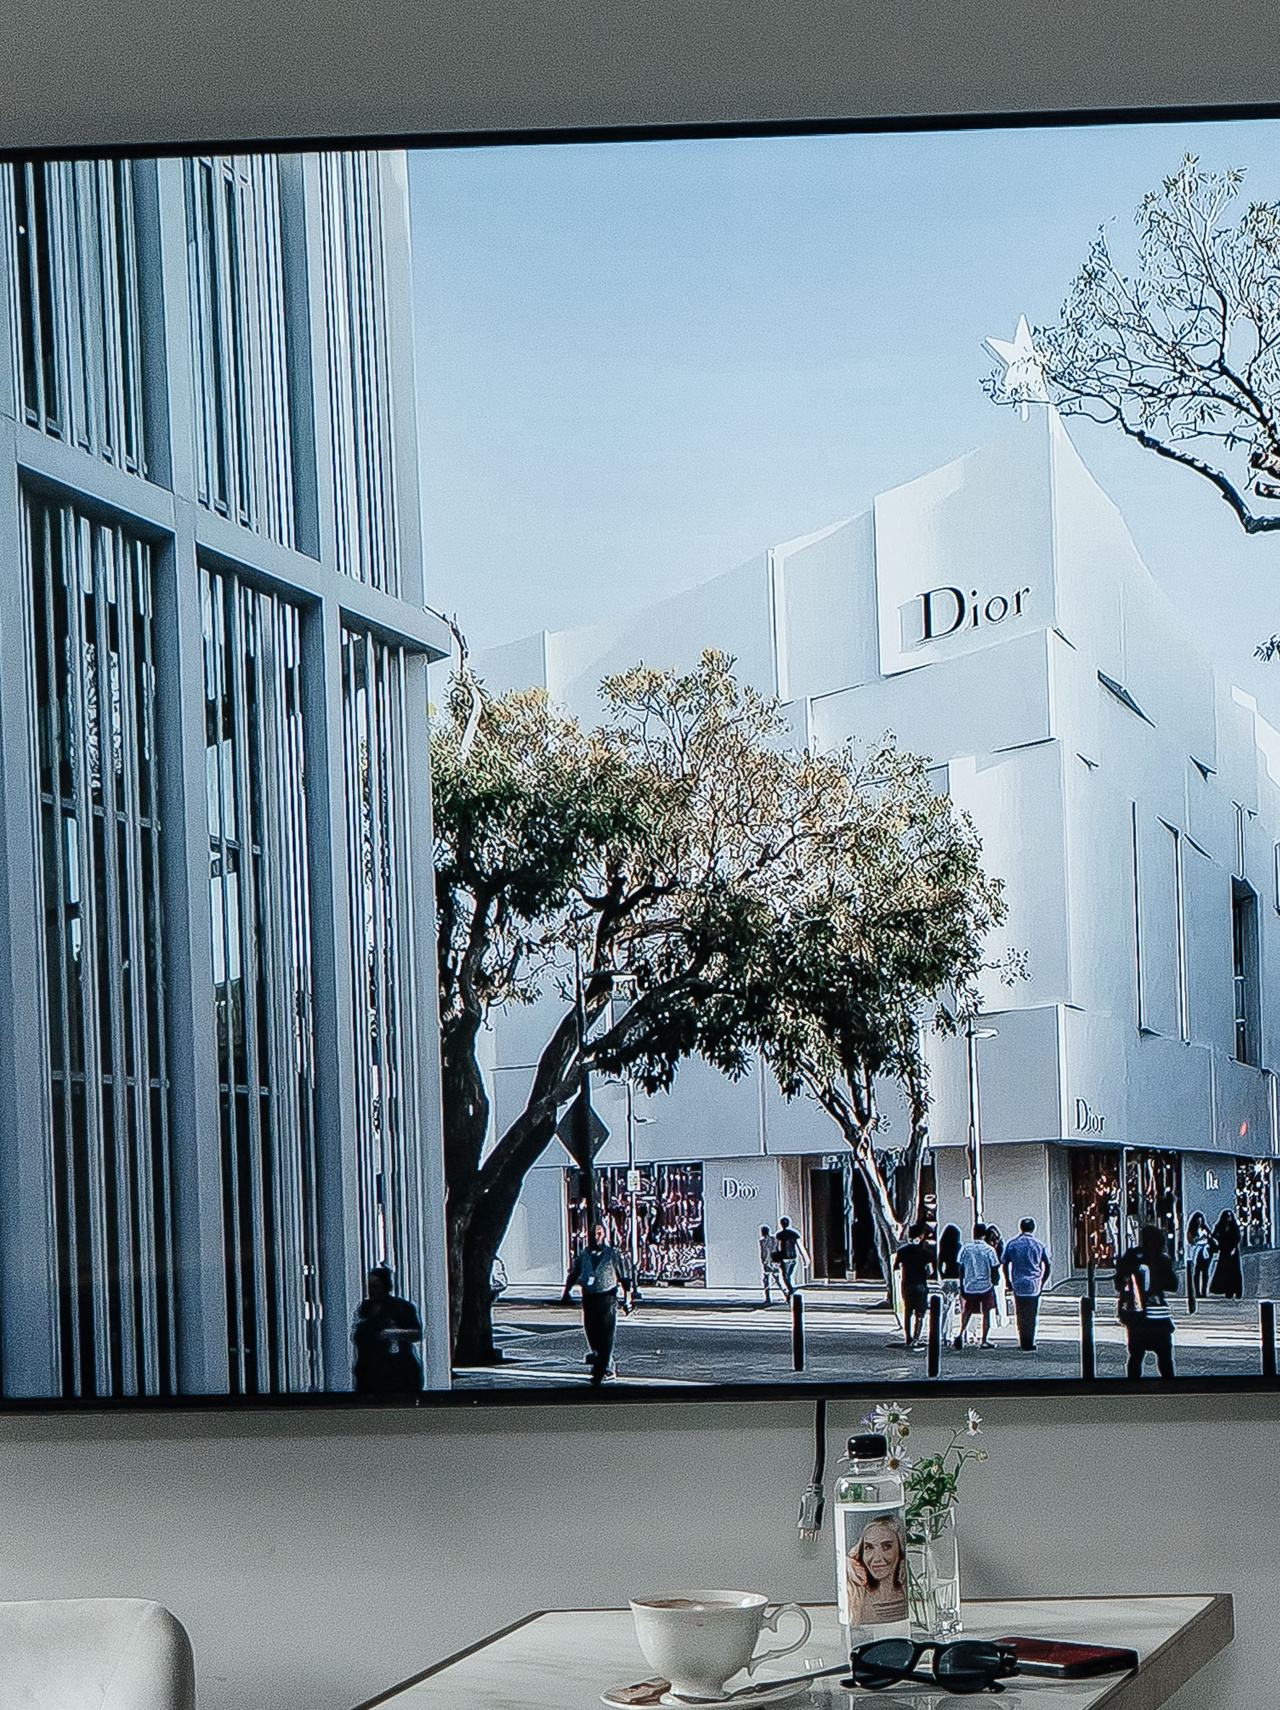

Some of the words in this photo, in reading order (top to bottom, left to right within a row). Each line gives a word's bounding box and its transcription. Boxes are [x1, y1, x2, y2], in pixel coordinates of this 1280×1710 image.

[916, 586, 1030, 643] Dior
[1075, 1098, 1105, 1134] Dior
[722, 1179, 758, 1198] Dior
